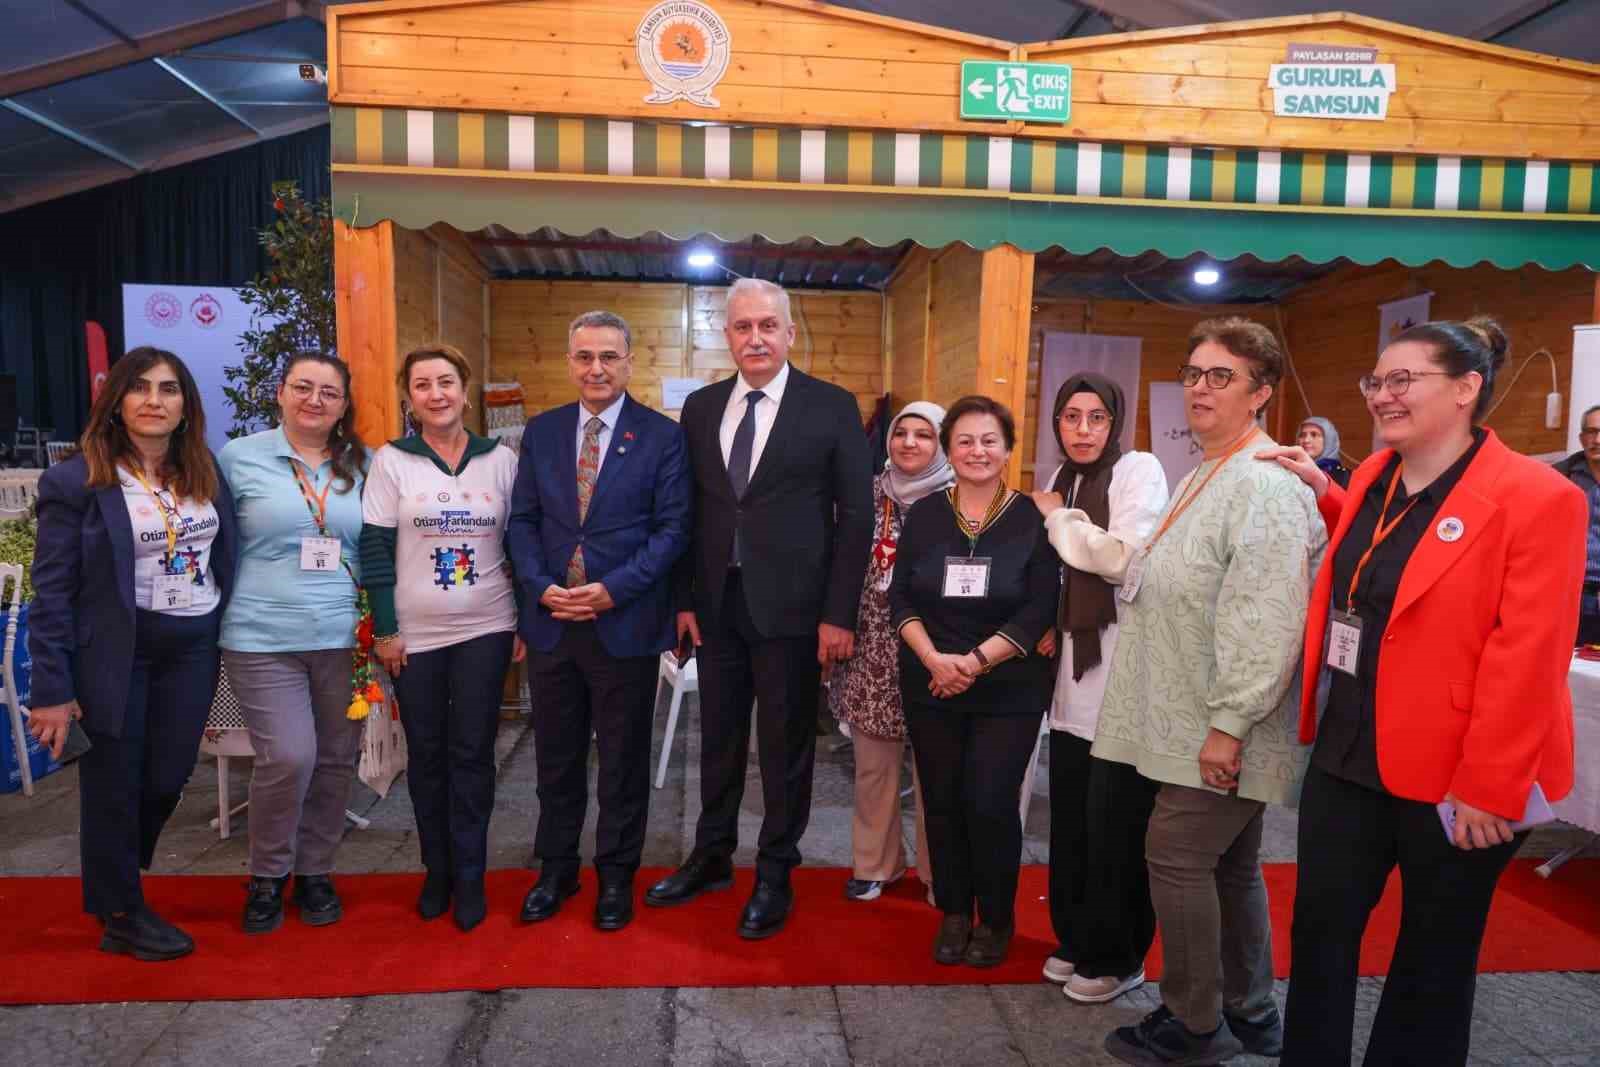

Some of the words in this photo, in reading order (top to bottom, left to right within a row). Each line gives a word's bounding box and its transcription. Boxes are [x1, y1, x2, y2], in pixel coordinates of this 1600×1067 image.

[1277, 67, 1386, 88] GURURLA
[1034, 95, 1065, 110] EXIT
[1283, 95, 1380, 114] SAMSUN
[413, 516, 441, 528] Otizm
